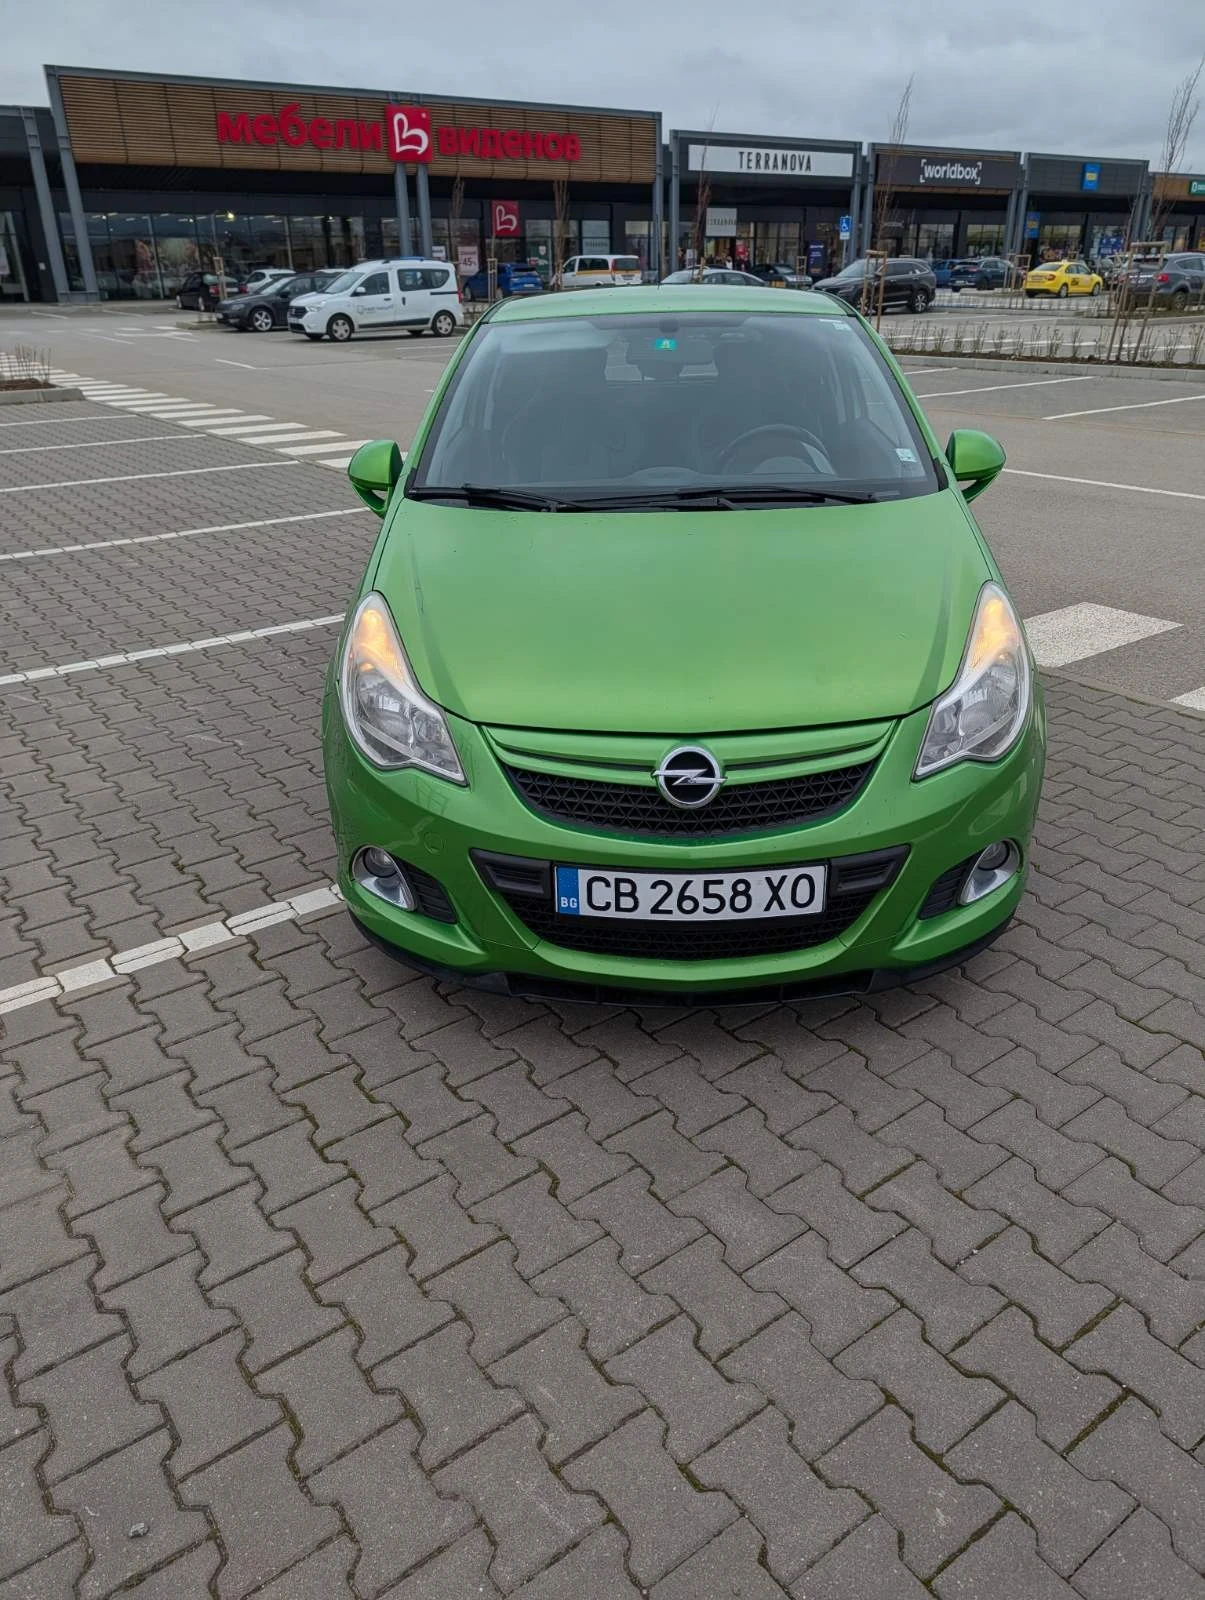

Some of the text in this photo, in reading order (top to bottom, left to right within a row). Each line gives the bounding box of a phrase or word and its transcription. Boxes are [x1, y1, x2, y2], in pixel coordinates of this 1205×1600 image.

[216, 101, 582, 162] мебели виденов
[738, 150, 813, 173] TERRANOVA
[560, 896, 578, 909] BG
[586, 873, 816, 915] CB 2658 XO
